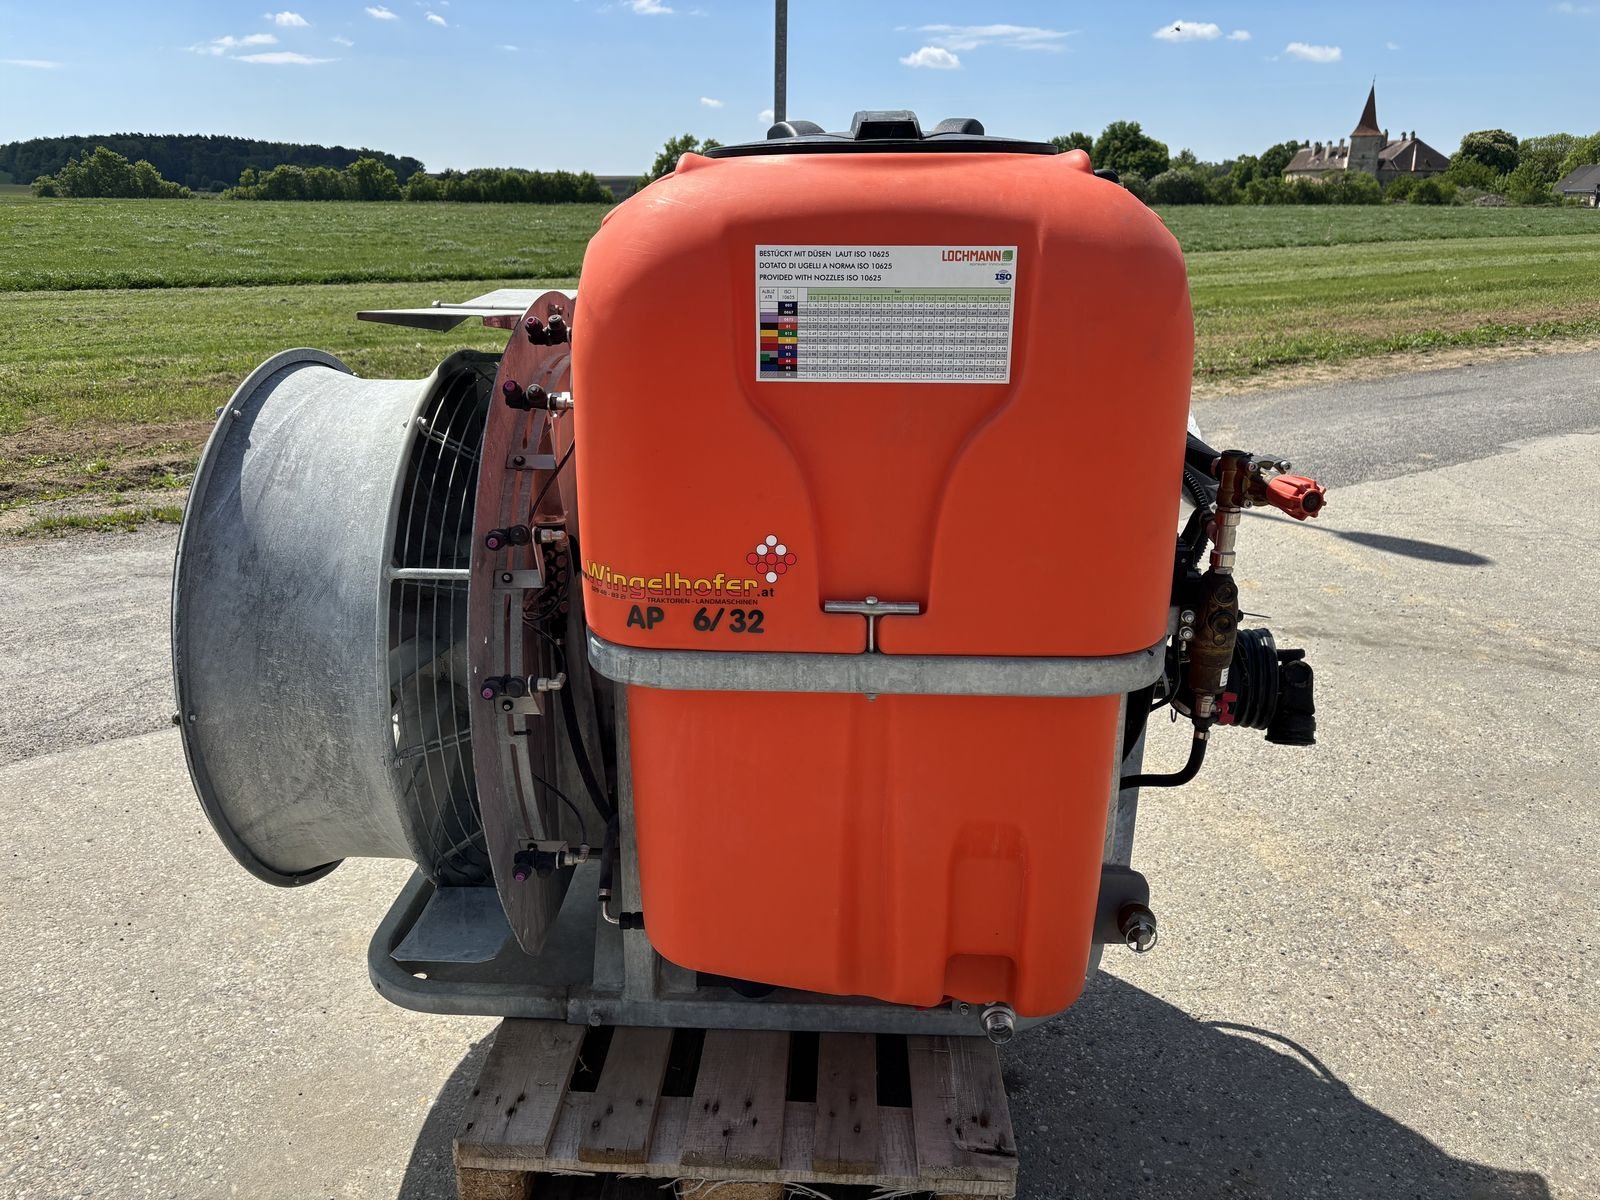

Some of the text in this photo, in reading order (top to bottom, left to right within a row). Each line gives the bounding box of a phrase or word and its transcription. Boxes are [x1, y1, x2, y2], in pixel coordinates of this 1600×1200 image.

[759, 249, 792, 258] BESTÜCKT
[793, 250, 806, 258] MIT
[807, 249, 832, 258] DÜSEN
[835, 250, 853, 258] LAUT
[854, 250, 867, 258] ISO
[942, 250, 1001, 261] LOCHMANN
[759, 261, 788, 270] DOTATO
[788, 262, 797, 270] DI
[798, 262, 821, 270] UGELLI
[822, 262, 829, 270] A
[829, 262, 856, 270] NORMA
[759, 273, 882, 282] PROVIDED WITH NOZZLES ISO 10625
[995, 273, 1012, 281] ISO
[627, 604, 664, 629] AP
